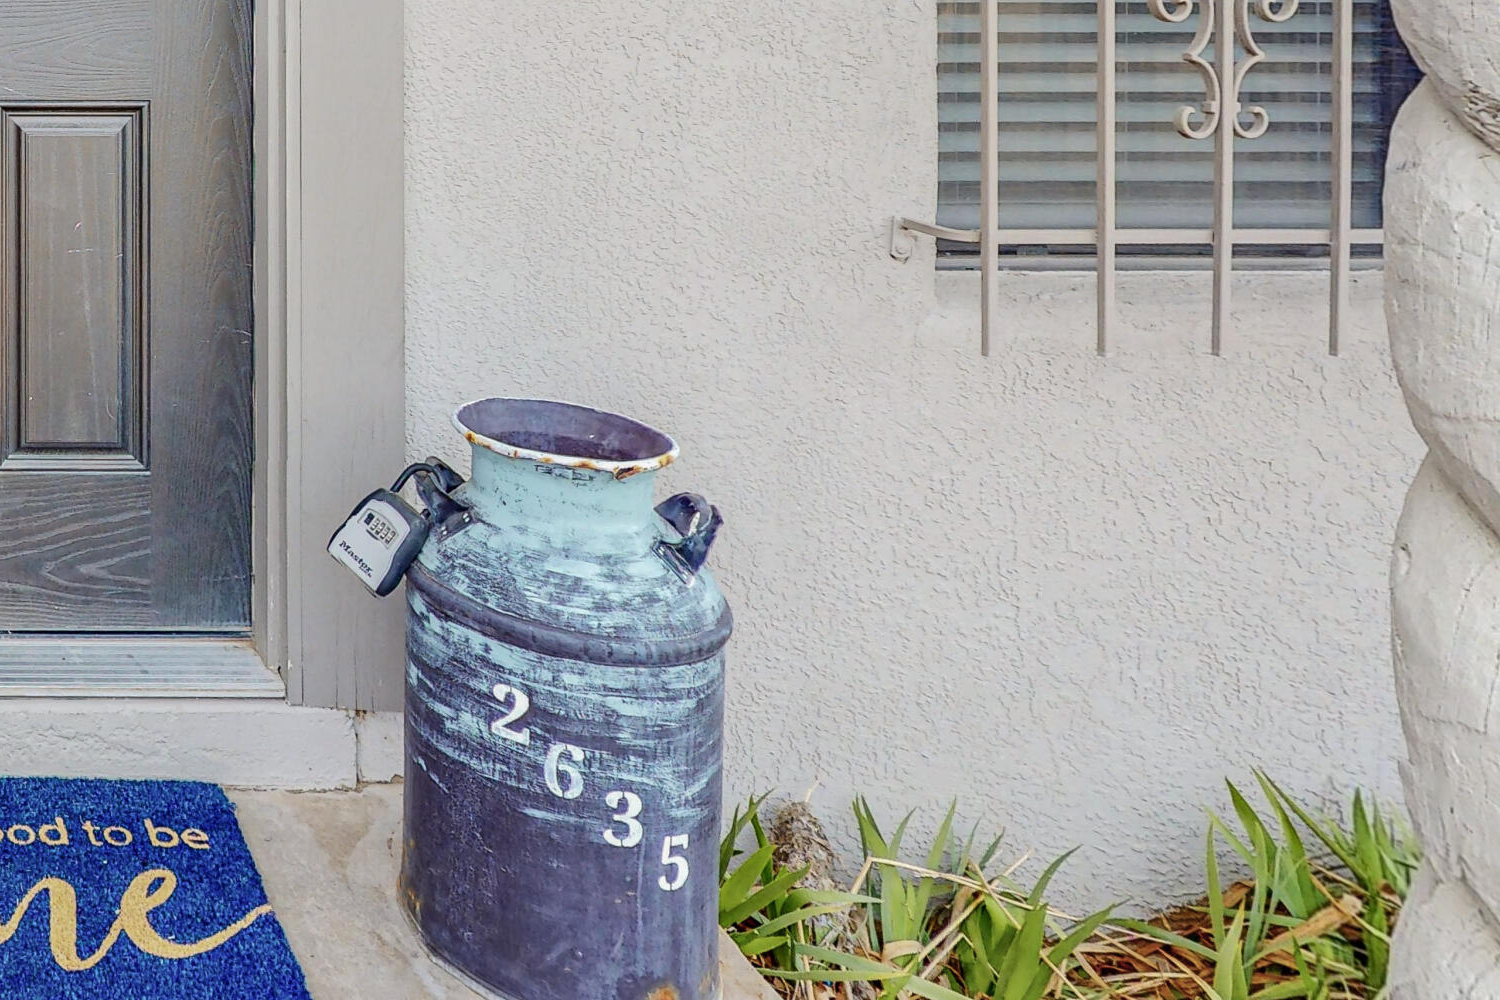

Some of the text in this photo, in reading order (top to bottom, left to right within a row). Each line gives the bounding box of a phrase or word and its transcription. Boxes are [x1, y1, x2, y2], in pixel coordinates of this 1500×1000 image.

[338, 540, 373, 574] Master
[82, 818, 133, 846] to
[143, 818, 210, 849] be
